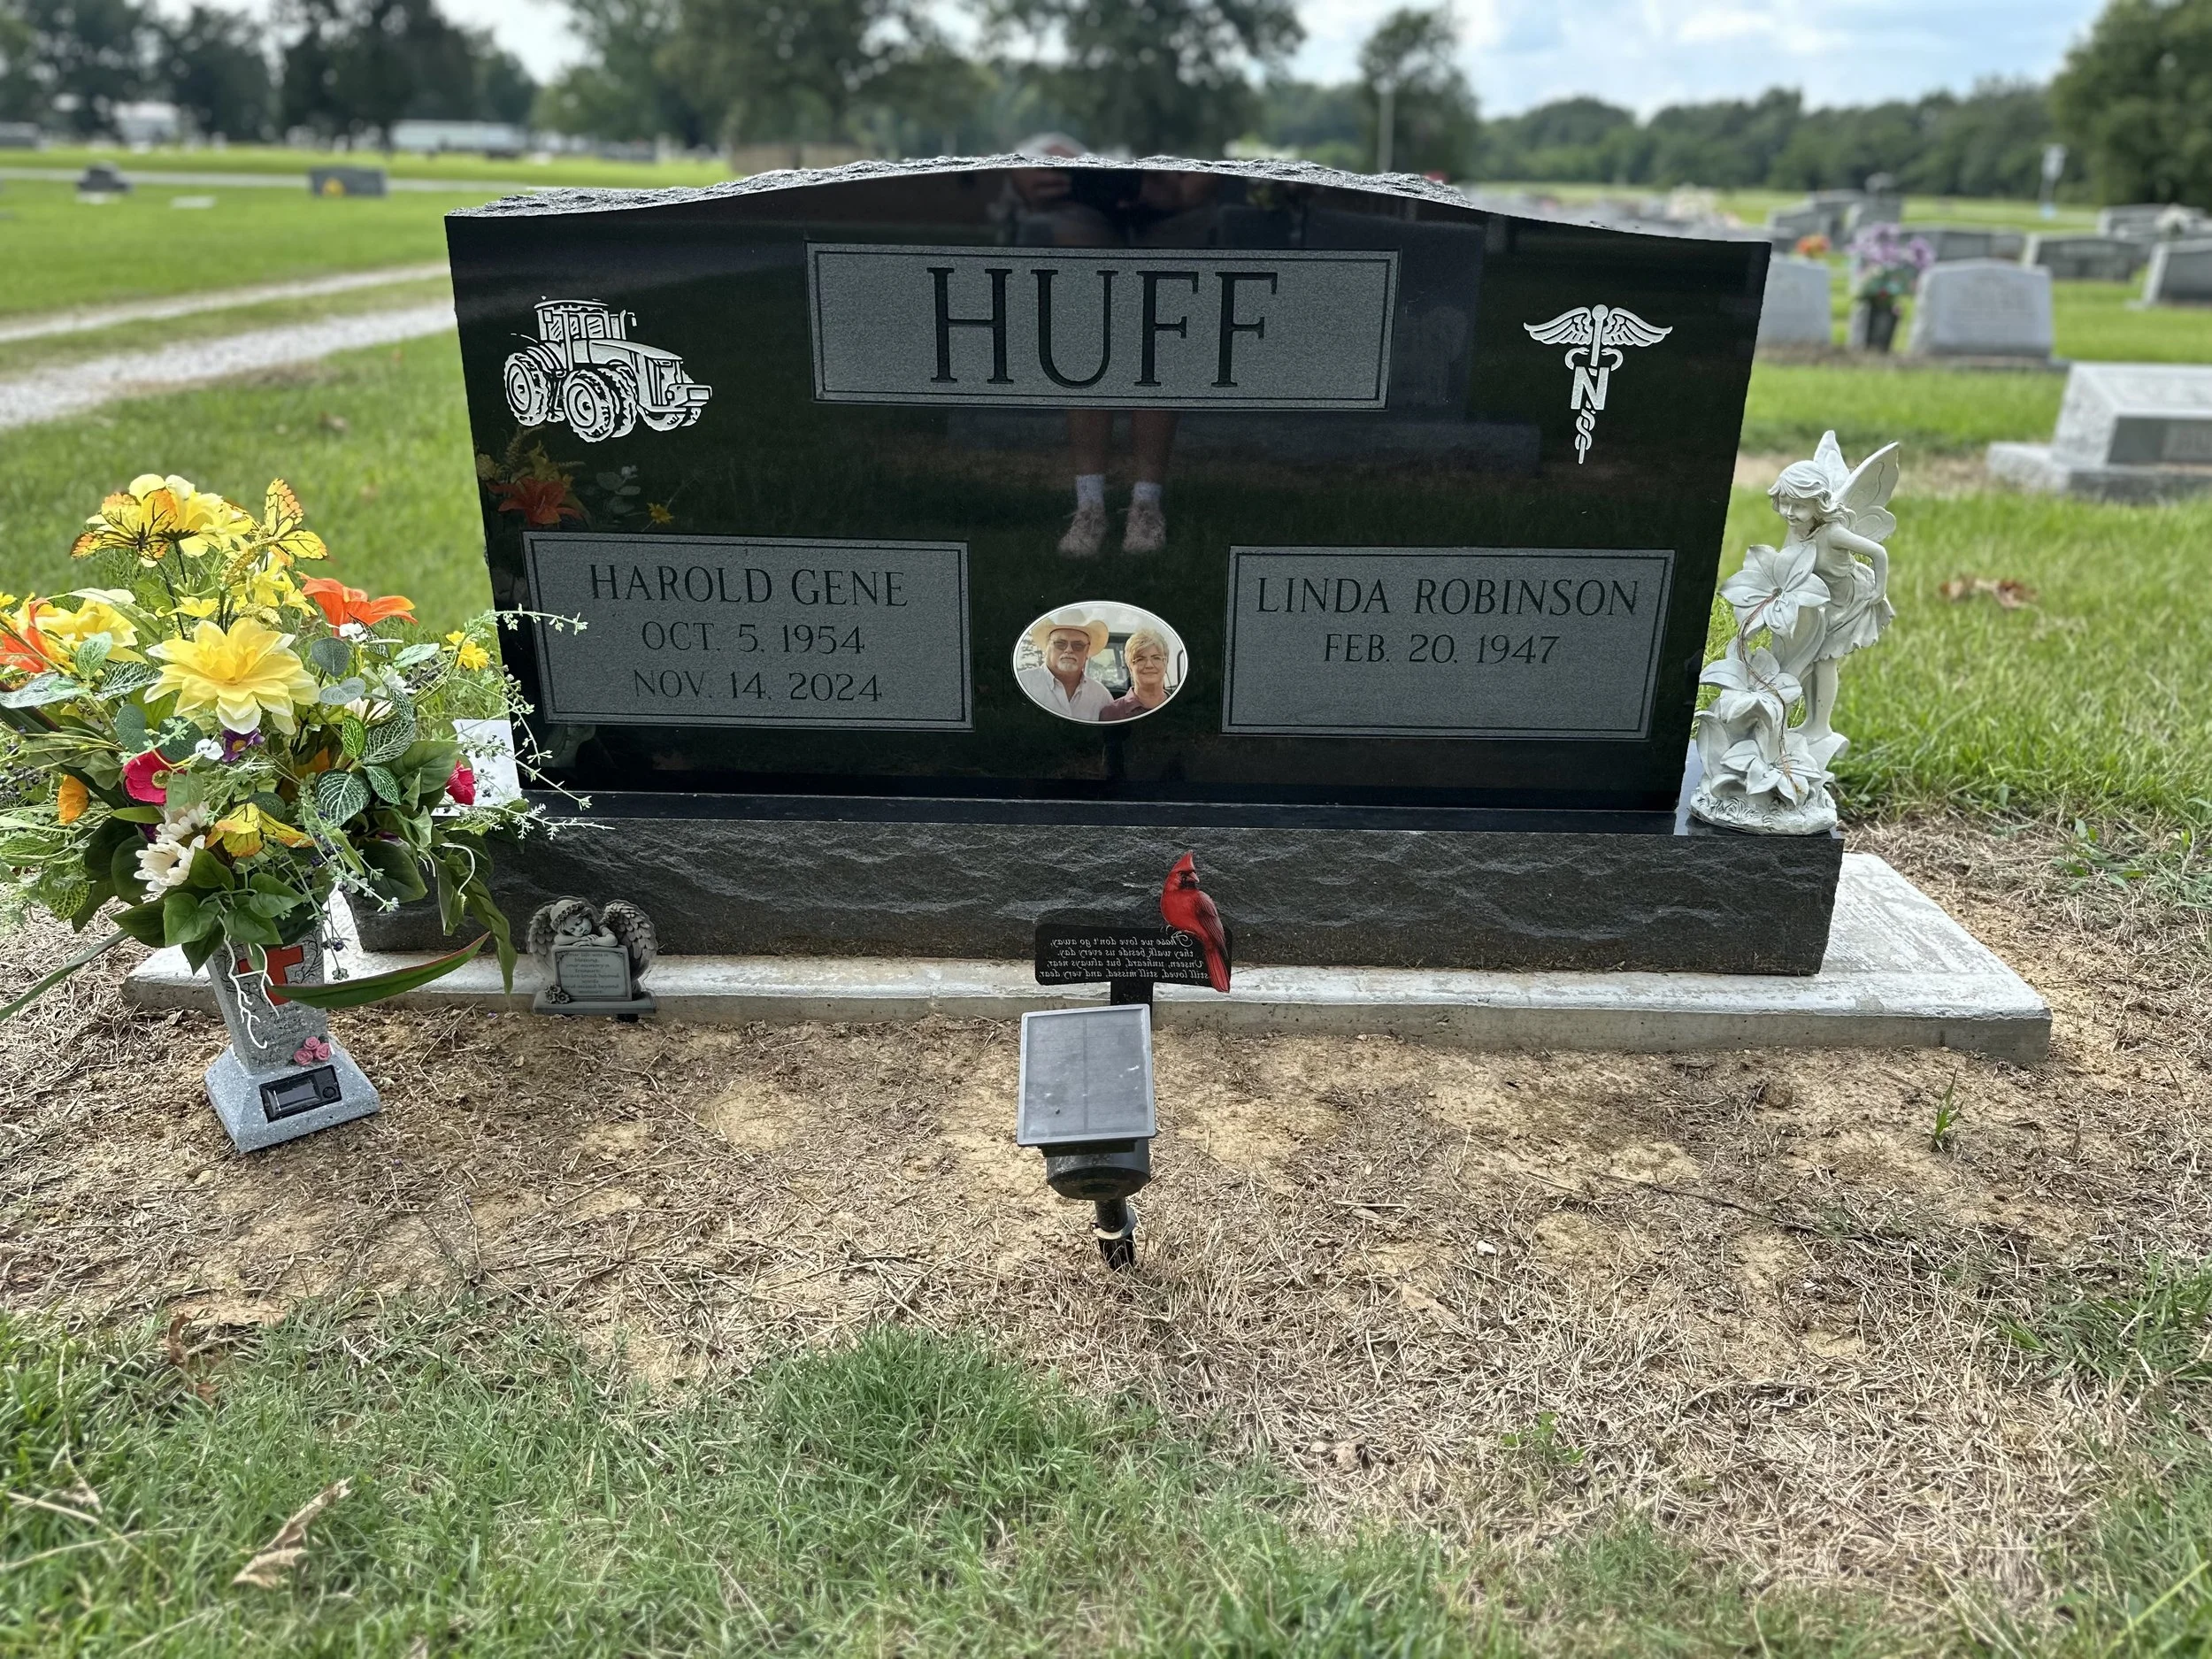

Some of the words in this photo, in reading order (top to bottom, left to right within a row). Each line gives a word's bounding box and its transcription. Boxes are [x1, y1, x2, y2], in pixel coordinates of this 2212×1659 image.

[926, 267, 1278, 388] HUFF
[589, 564, 772, 603] HAROLD
[791, 569, 908, 607] GENE
[1256, 578, 1390, 614] LINDA
[1414, 579, 1638, 616] ROBINSON
[641, 621, 721, 652] OCT.
[782, 625, 865, 655] 1954
[1324, 634, 1390, 663] FEB.
[1477, 636, 1560, 664] 1947
[634, 670, 712, 699] NOV.
[789, 672, 882, 702] 2024
